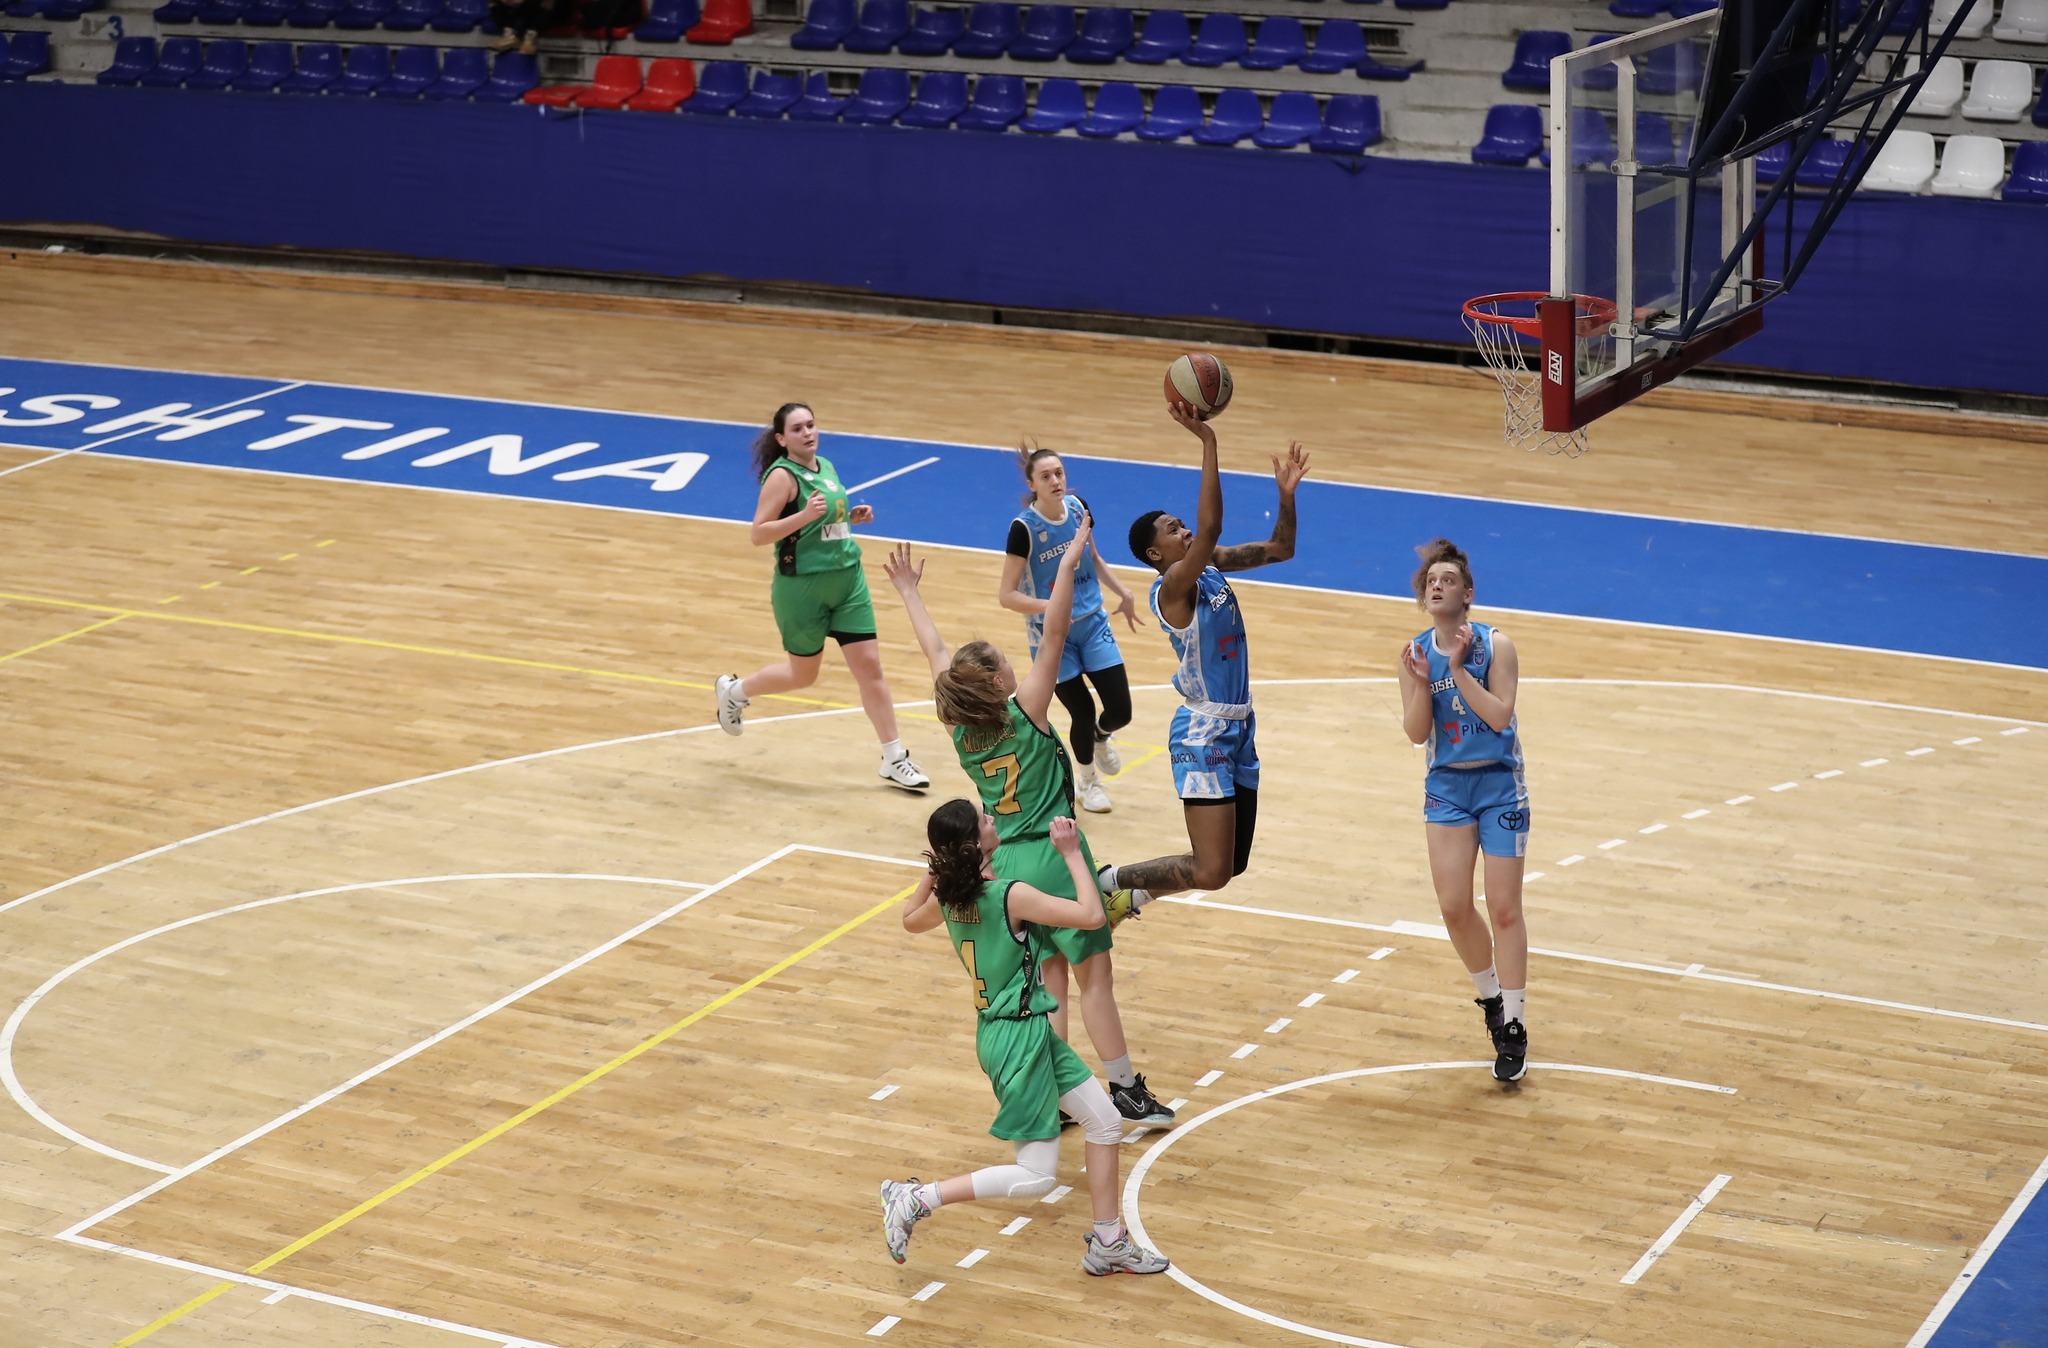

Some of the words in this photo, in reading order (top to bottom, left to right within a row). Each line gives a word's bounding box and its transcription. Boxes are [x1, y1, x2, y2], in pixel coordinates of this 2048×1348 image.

[1549, 350, 1562, 385] ELAN
[0, 388, 710, 492] SHTINA
[1451, 695, 1466, 715] 4
[981, 752, 1022, 815] 7
[960, 940, 990, 1010] 4
